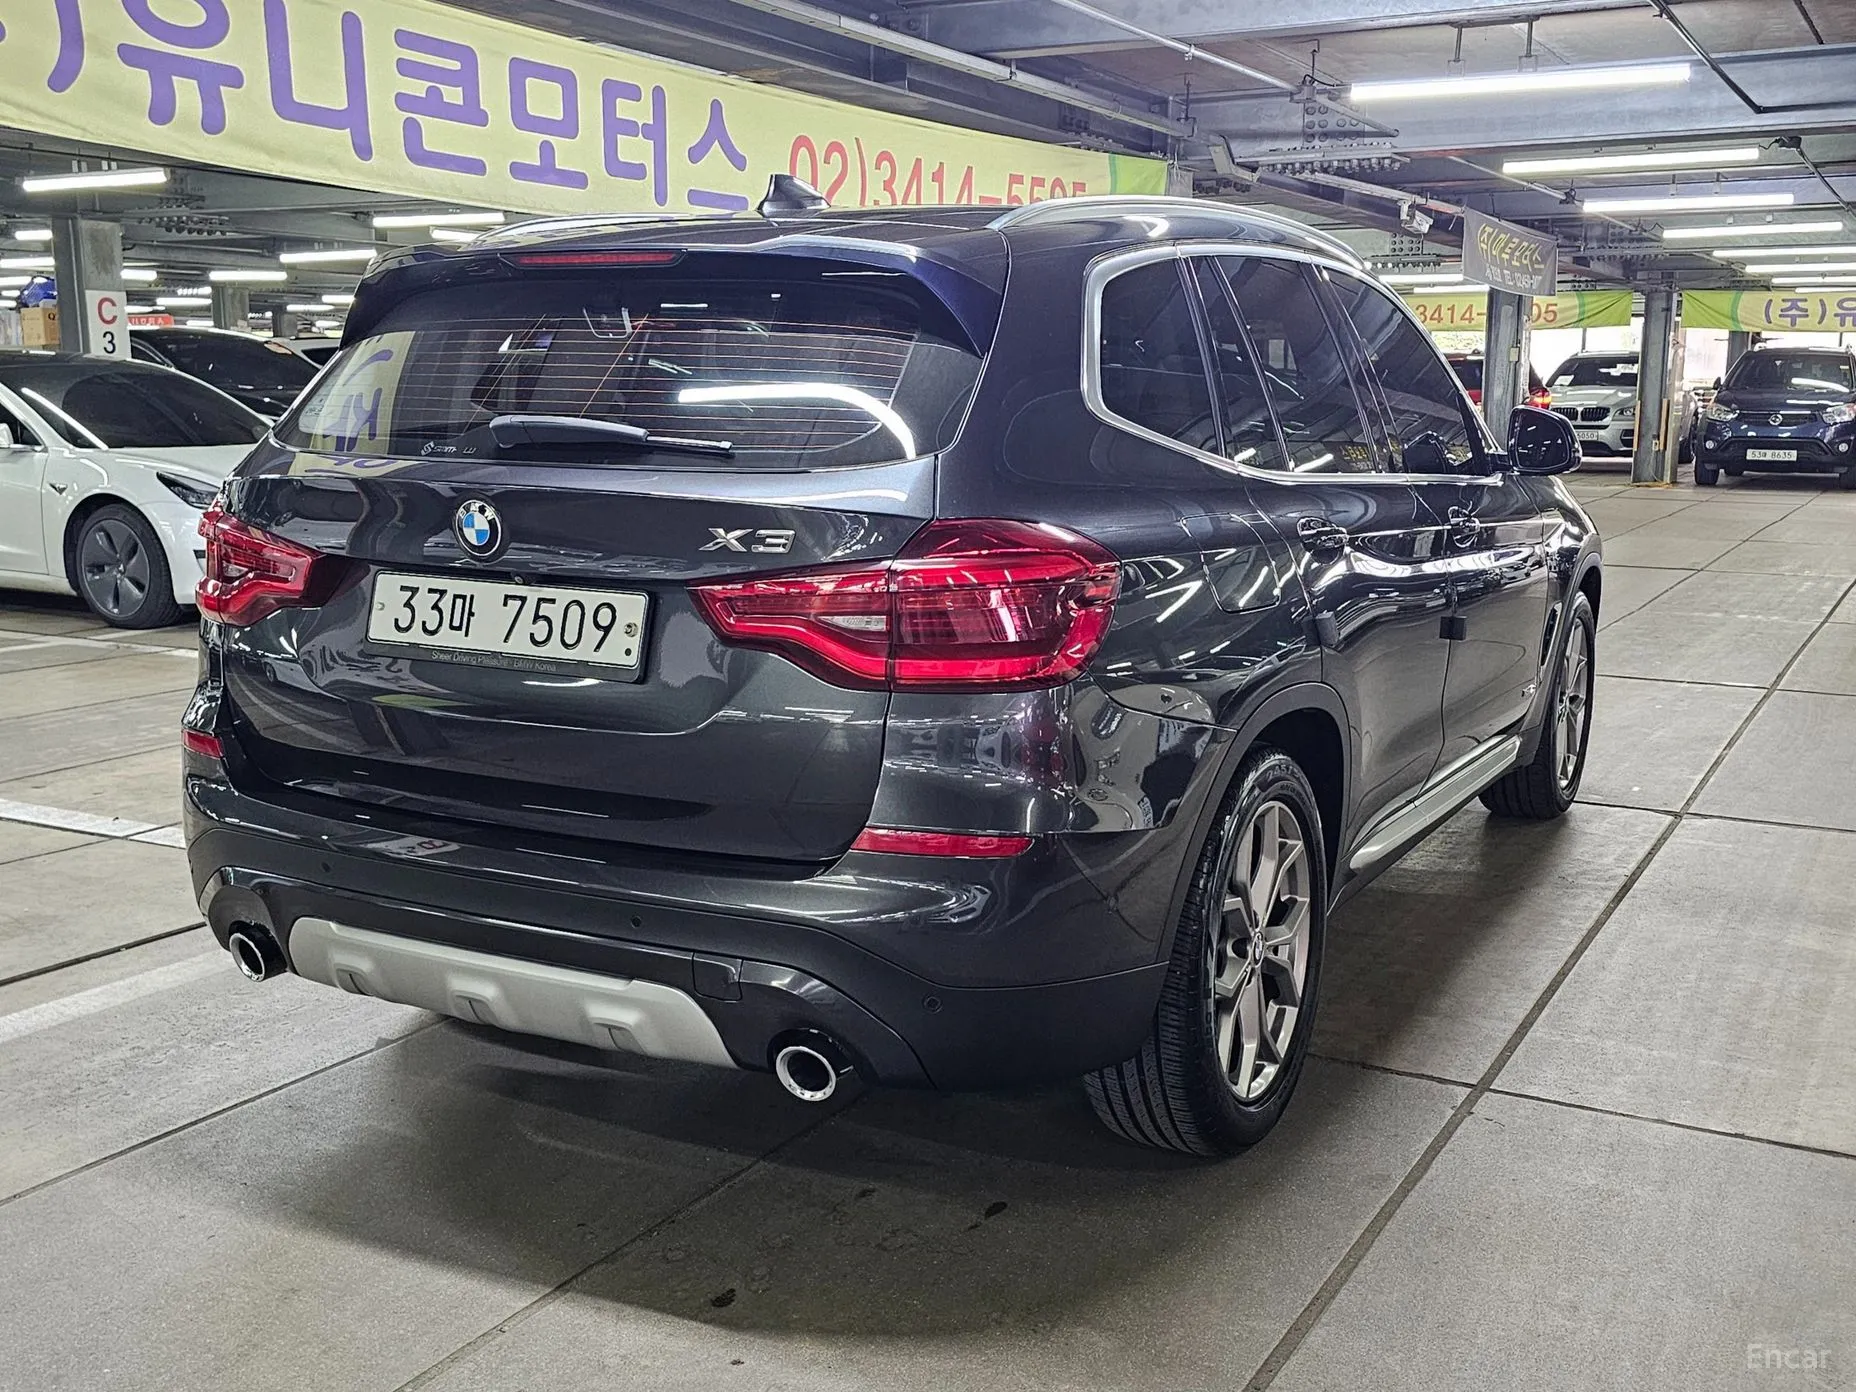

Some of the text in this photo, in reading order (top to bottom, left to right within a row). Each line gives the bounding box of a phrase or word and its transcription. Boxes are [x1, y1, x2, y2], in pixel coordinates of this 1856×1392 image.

[0, 0, 749, 211] )유니콘모터스
[97, 297, 118, 325] C
[103, 331, 116, 354] 3
[459, 502, 495, 521] BMW
[698, 527, 796, 554] X3
[393, 584, 618, 653] 33마 7509
[513, 659, 533, 669] BMW
[534, 662, 557, 672] Korea
